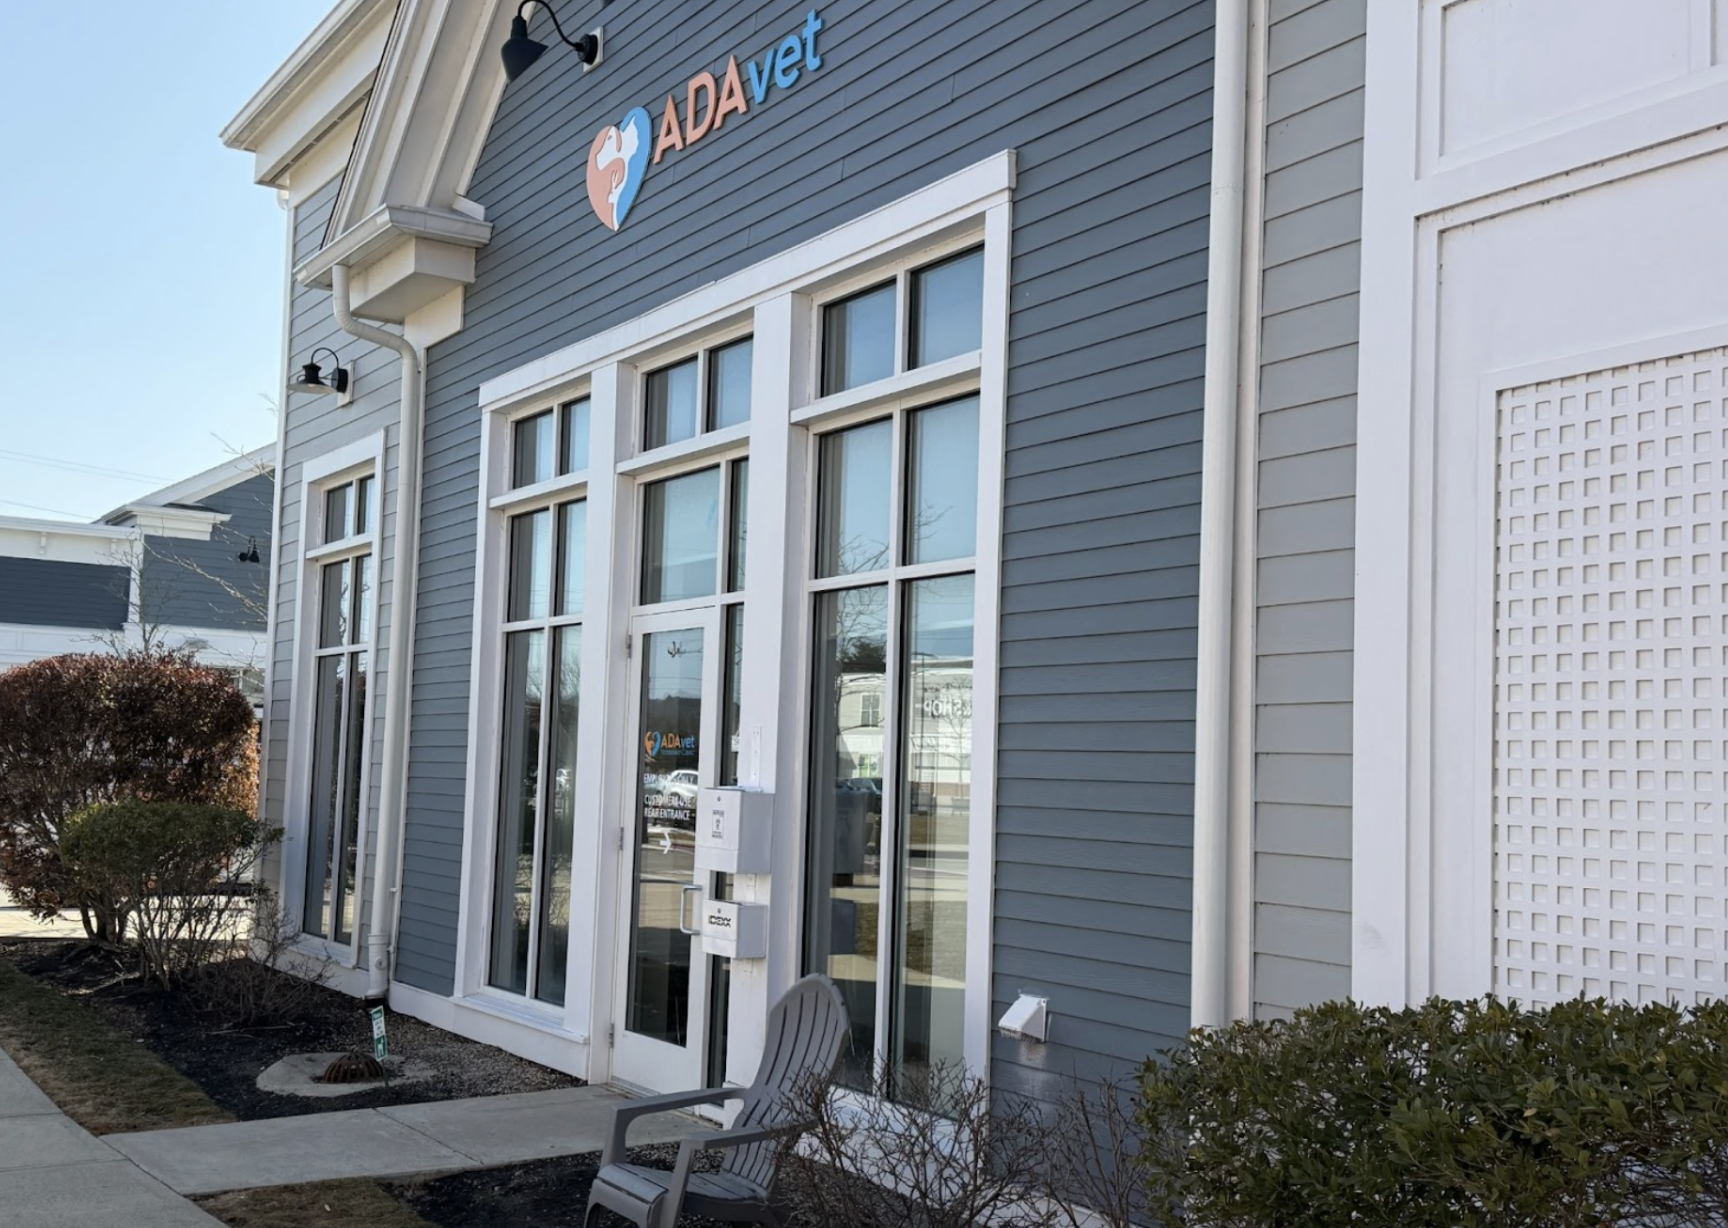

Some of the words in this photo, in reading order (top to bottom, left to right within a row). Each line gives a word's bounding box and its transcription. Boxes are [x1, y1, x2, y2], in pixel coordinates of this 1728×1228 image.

[653, 9, 824, 164] ADAvet
[661, 733, 695, 748] ADAvet
[644, 807, 660, 818] REAR
[661, 808, 690, 821] ENTRANCE
